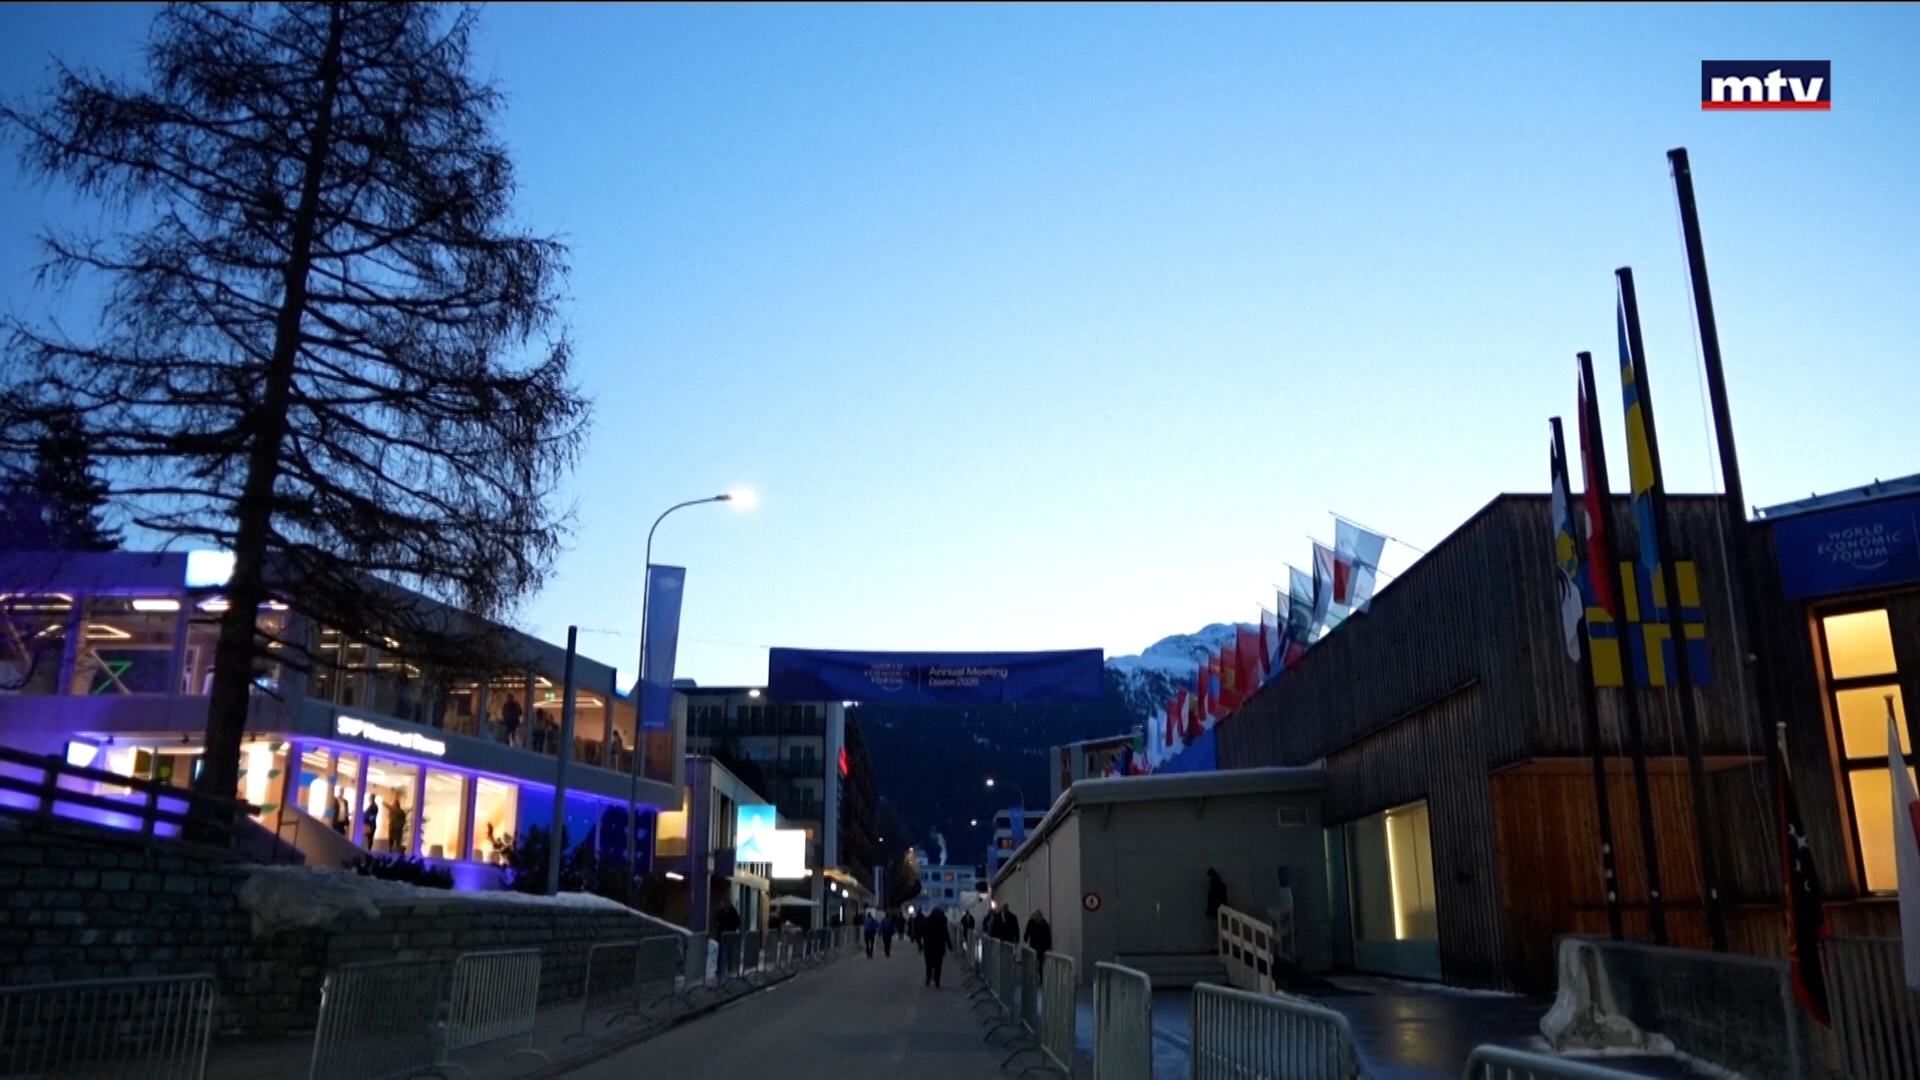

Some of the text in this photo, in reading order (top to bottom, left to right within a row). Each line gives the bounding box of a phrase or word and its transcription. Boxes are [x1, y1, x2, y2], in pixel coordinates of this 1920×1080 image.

[1828, 523, 1884, 540] WORLD
[1817, 531, 1900, 554] ECONOMIC
[1832, 547, 1888, 562] FORUM
[929, 667, 1008, 679] Annual Meeting
